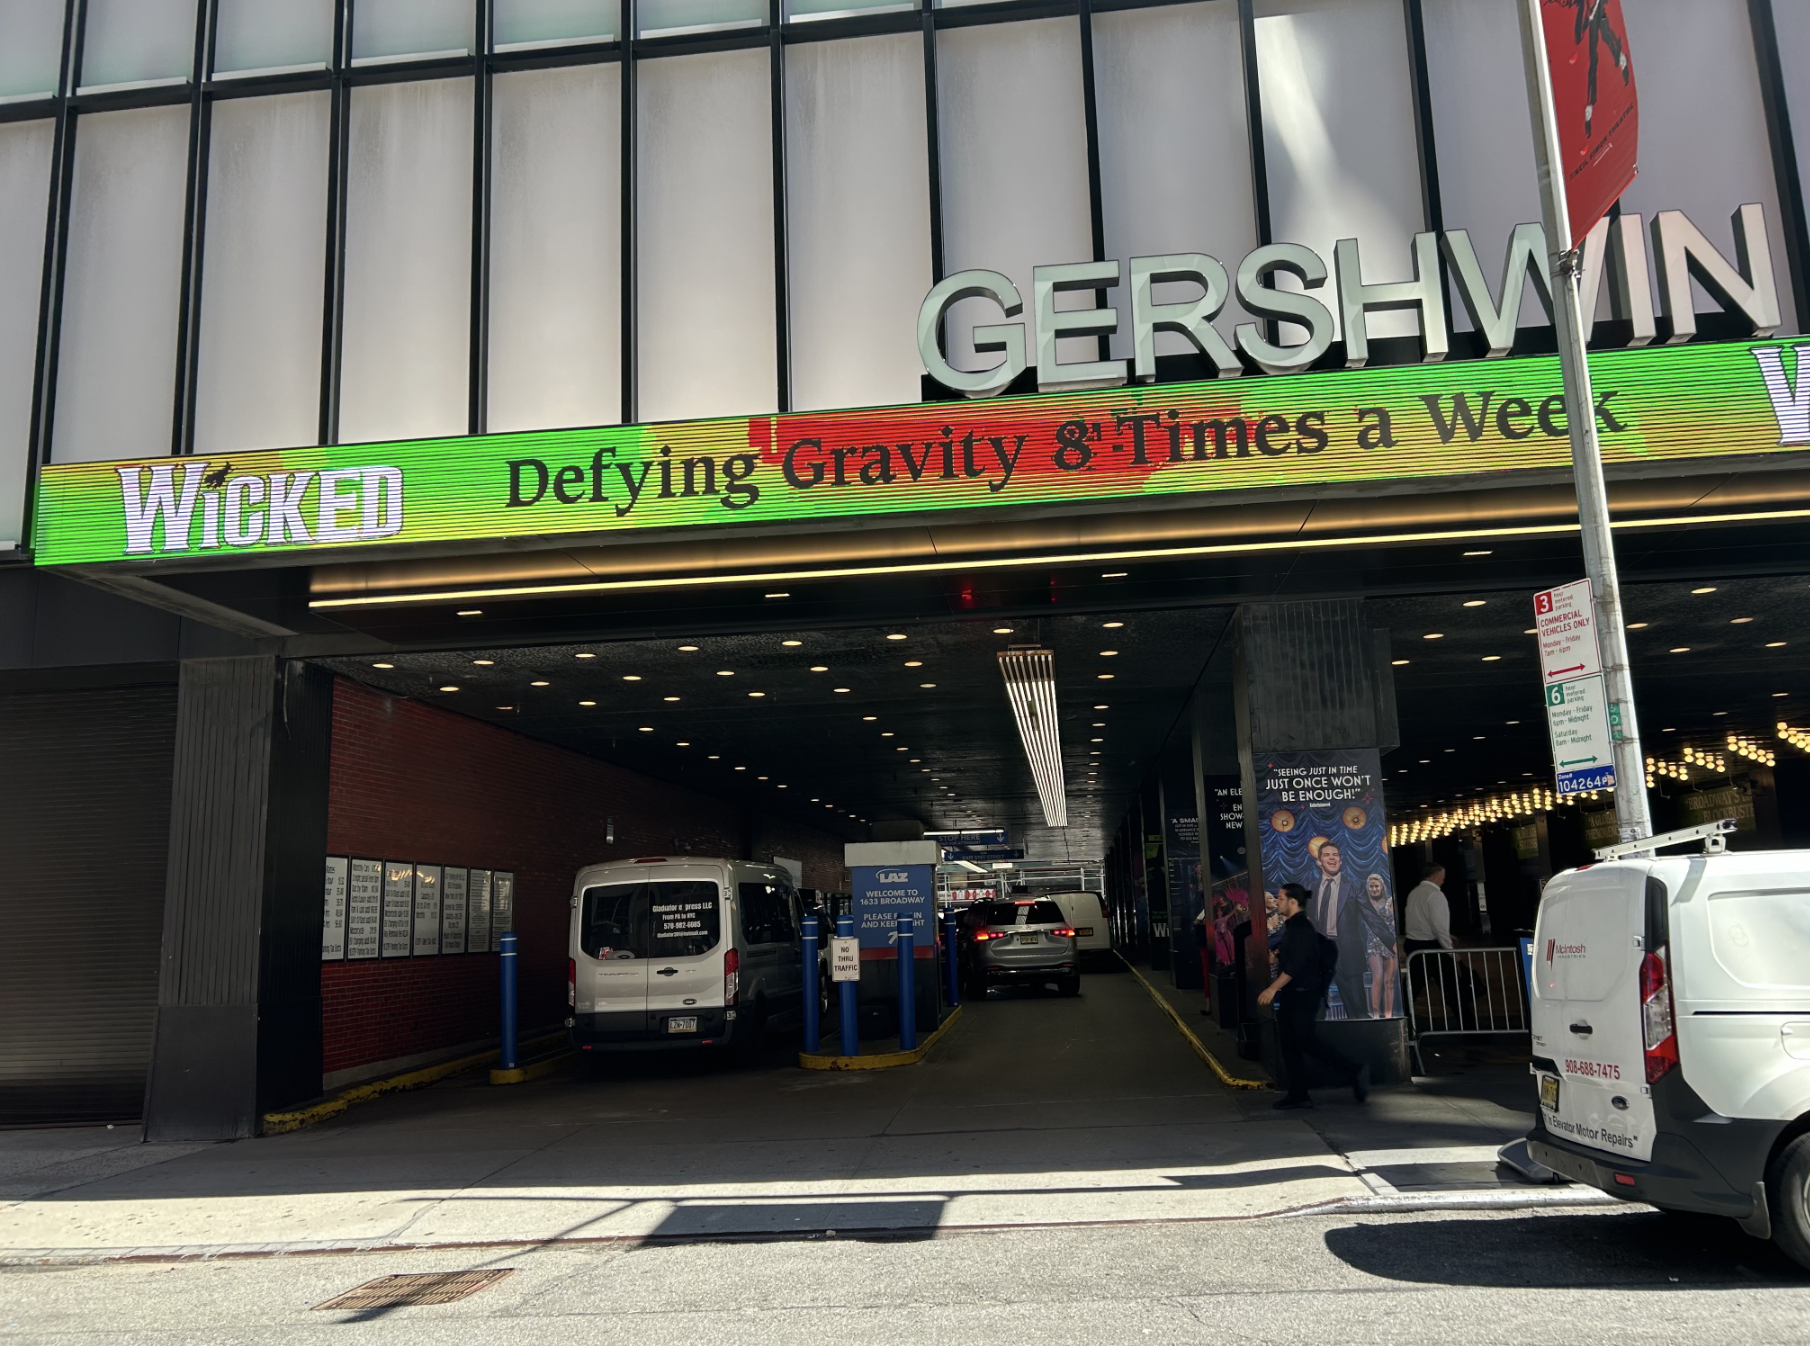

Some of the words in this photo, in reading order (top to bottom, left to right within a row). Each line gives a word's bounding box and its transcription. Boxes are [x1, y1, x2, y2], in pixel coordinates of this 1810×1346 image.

[916, 202, 1782, 398] GERSHWIN
[504, 445, 761, 518] Defying
[782, 425, 1029, 493] Gravity
[1115, 408, 1330, 468] Times
[1357, 405, 1398, 451] a
[1420, 380, 1628, 446] Week
[1540, 596, 1550, 612] 3
[1556, 602, 1572, 611] parking
[1540, 610, 1582, 628] COMMERCIAL
[1542, 622, 1572, 637] VEHICLES
[1574, 617, 1590, 628] ONLY
[1543, 640, 1562, 650] Monday
[1566, 634, 1580, 643] Friday
[1551, 686, 1560, 704] 6
[1566, 688, 1586, 697] metered
[1566, 695, 1584, 704] parking
[1552, 710, 1572, 718] Monday
[1576, 704, 1592, 714] Friday
[1553, 718, 1564, 727] 6pm
[1568, 714, 1590, 724] Midnight
[1554, 729, 1578, 738] Saturday
[1570, 734, 1592, 744] Midnight
[1309, 766, 1326, 776] JUST
[1329, 766, 1337, 774] IN
[1340, 766, 1358, 774] TIME
[1266, 778, 1289, 790] JUST
[1292, 777, 1328, 788] ONCE
[1330, 775, 1371, 786] WON'T
[1558, 776, 1602, 792] 104264
[1282, 791, 1296, 802] BE
[1702, 804, 1755, 822] BLOCKBUSTE
[880, 872, 908, 883] LAZ
[702, 902, 712, 910] LLC
[880, 896, 925, 904] BROADWAY
[864, 912, 892, 920] PLEASE
[1556, 944, 1586, 954] McIntosh
[1565, 1059, 1620, 1080] 908-688-7475
[1552, 1116, 1576, 1134] Elevator
[1576, 1122, 1599, 1140] Motor
